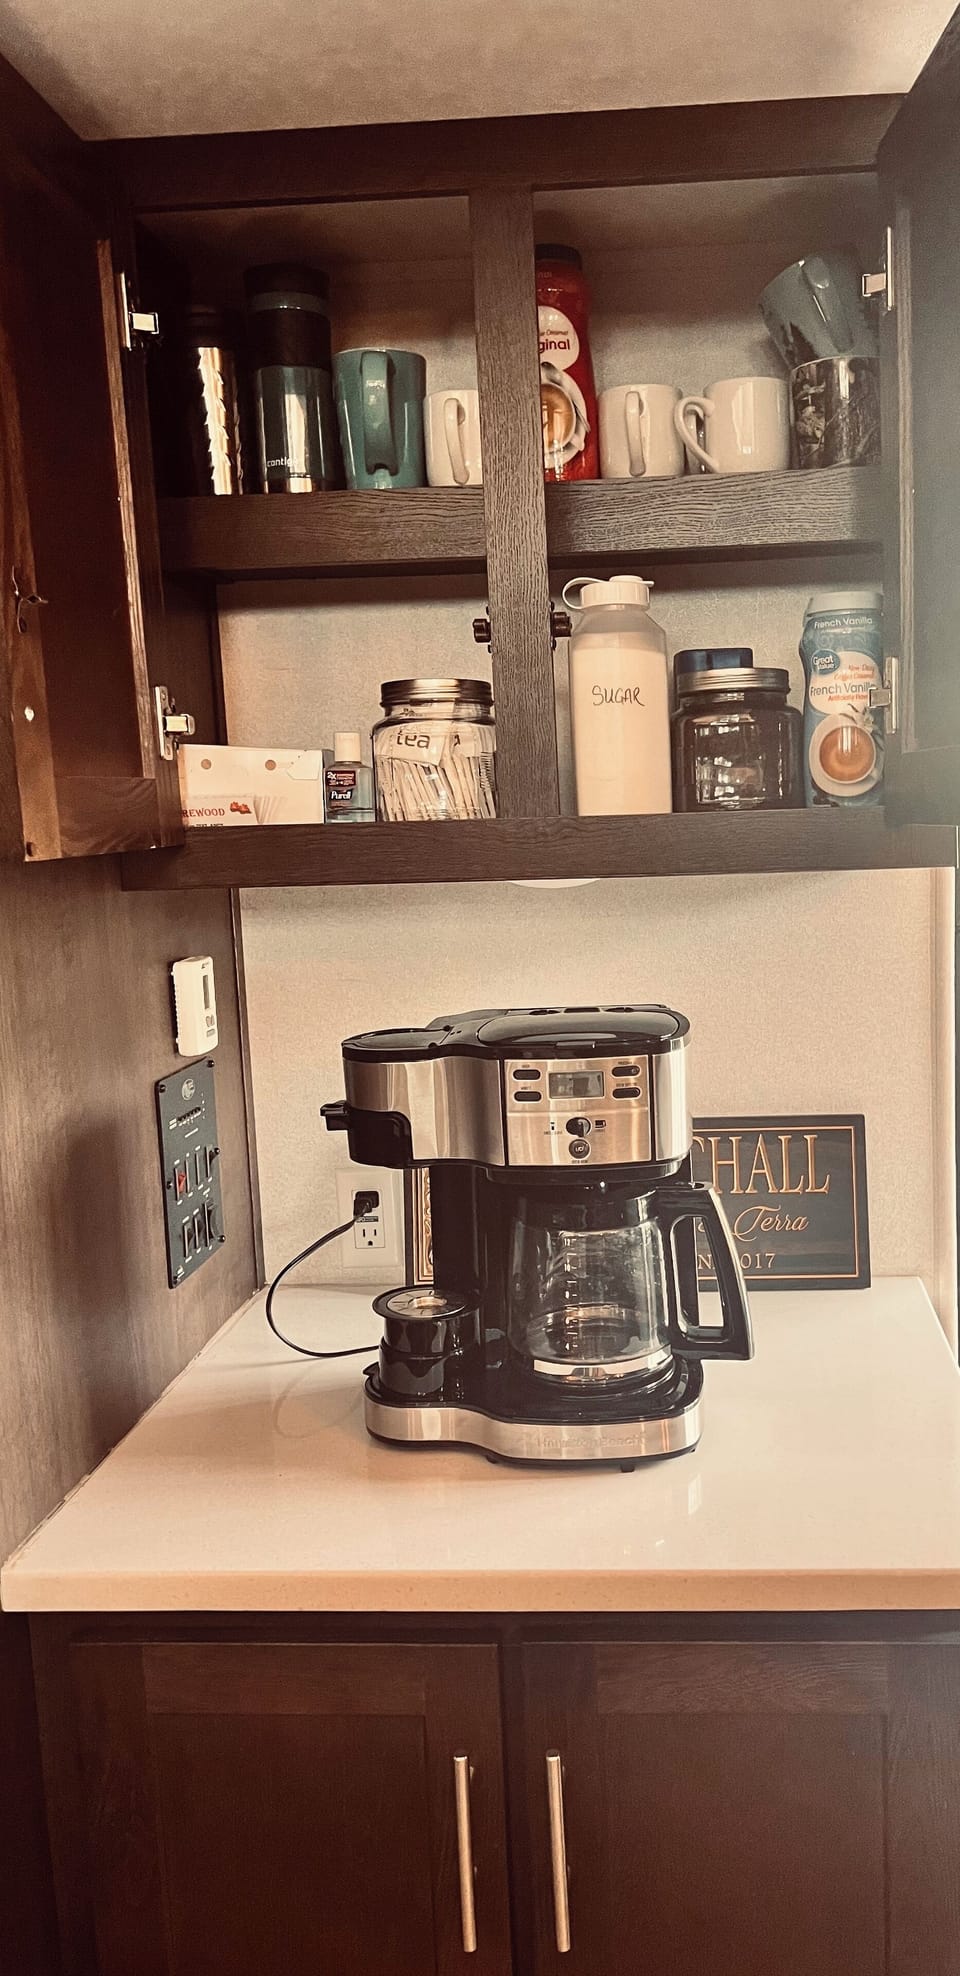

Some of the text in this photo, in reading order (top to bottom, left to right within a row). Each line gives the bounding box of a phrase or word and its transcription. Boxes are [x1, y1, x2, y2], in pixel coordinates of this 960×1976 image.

[539, 338, 570, 354] ginal
[267, 456, 292, 468] contig
[814, 616, 873, 629] French Vanilla
[813, 655, 834, 666] Great
[592, 685, 645, 707] SUGAR
[810, 683, 842, 697] French
[396, 730, 431, 749] tea
[181, 807, 226, 818] REWOOD
[733, 1204, 809, 1242] Terra
[740, 1252, 776, 1270] 017
